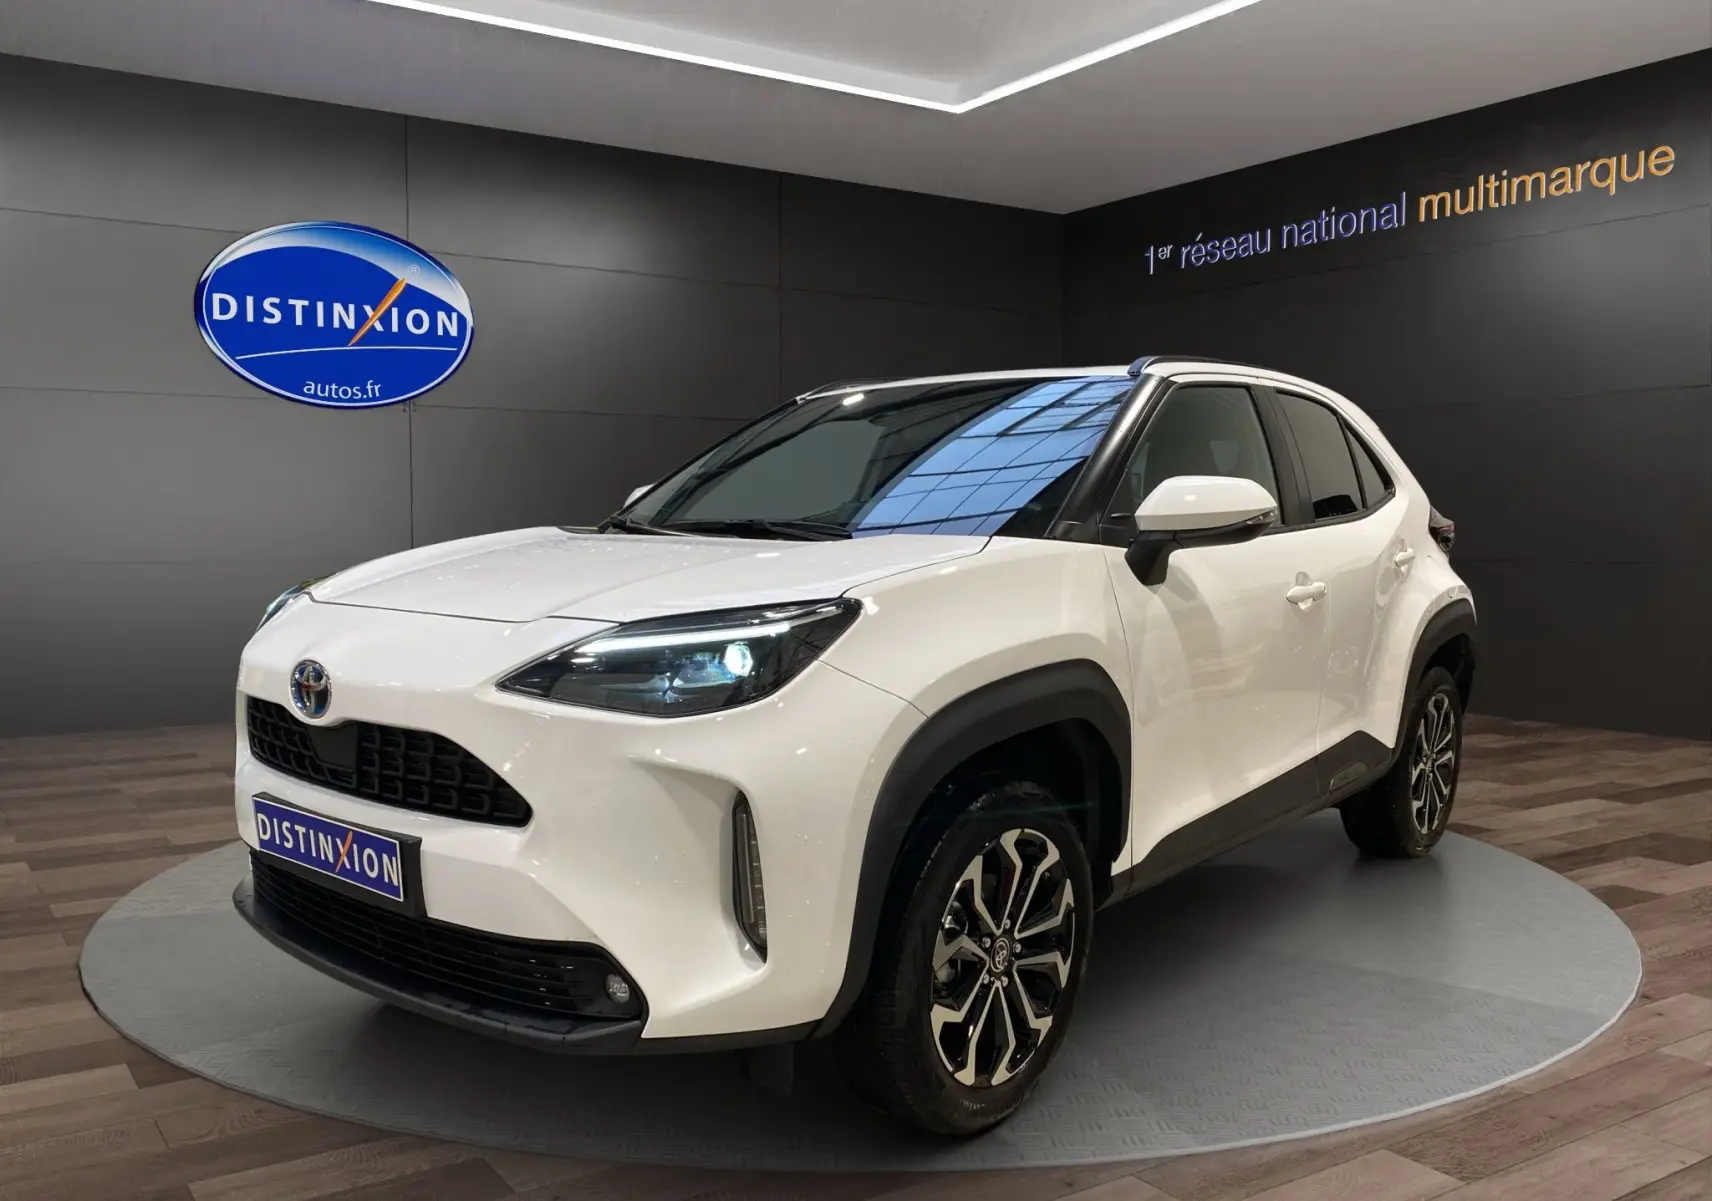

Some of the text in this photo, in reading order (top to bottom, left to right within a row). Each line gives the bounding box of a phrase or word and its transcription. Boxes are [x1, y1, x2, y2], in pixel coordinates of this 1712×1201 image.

[1180, 232, 1272, 269] réseau
[1282, 191, 1406, 250] national
[1418, 145, 1676, 222] multimarque
[211, 279, 458, 345] DISTINXION
[303, 379, 382, 399] autos.fr
[257, 813, 399, 887] DISTINXION
